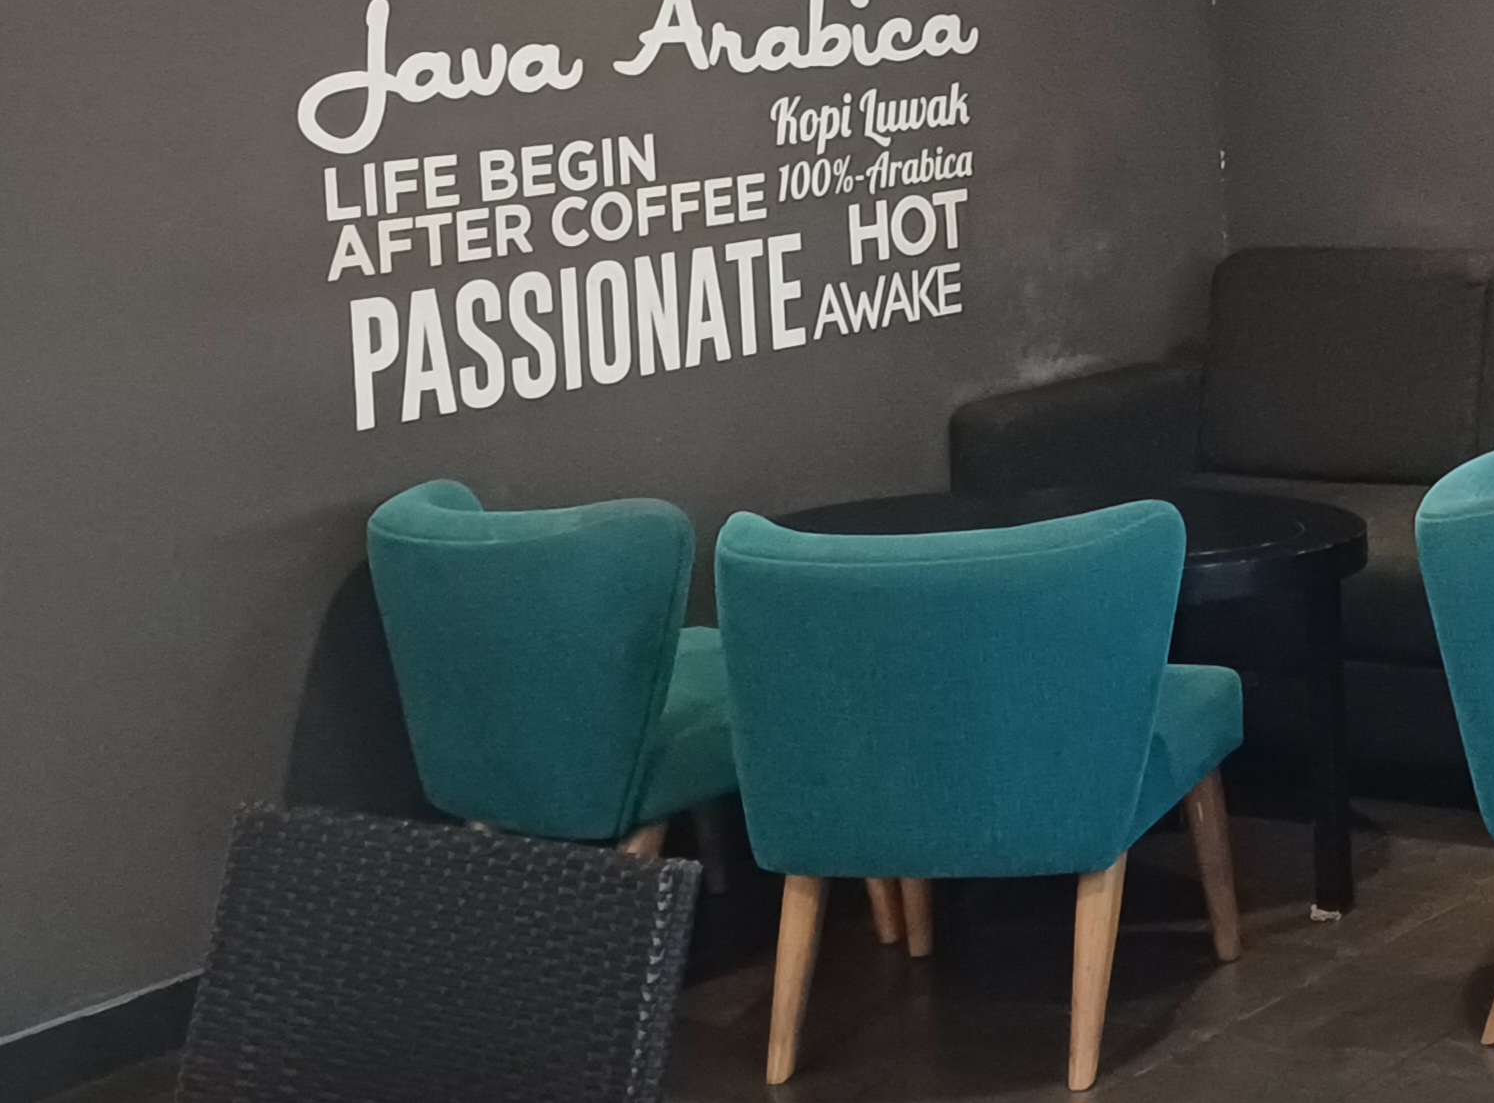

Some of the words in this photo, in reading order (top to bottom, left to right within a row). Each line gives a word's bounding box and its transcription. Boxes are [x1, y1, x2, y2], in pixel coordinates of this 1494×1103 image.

[769, 92, 853, 156] Kopi
[858, 81, 972, 148] Luwak
[323, 160, 461, 222] LIFE
[479, 132, 657, 203] BEGIN
[777, 146, 974, 203] 100%-Arabica
[327, 210, 534, 282] AFTER
[551, 171, 768, 247] COFFEE
[847, 188, 968, 266] HOT
[349, 232, 807, 432] PASSIONATE
[813, 262, 963, 340] AWAKE
